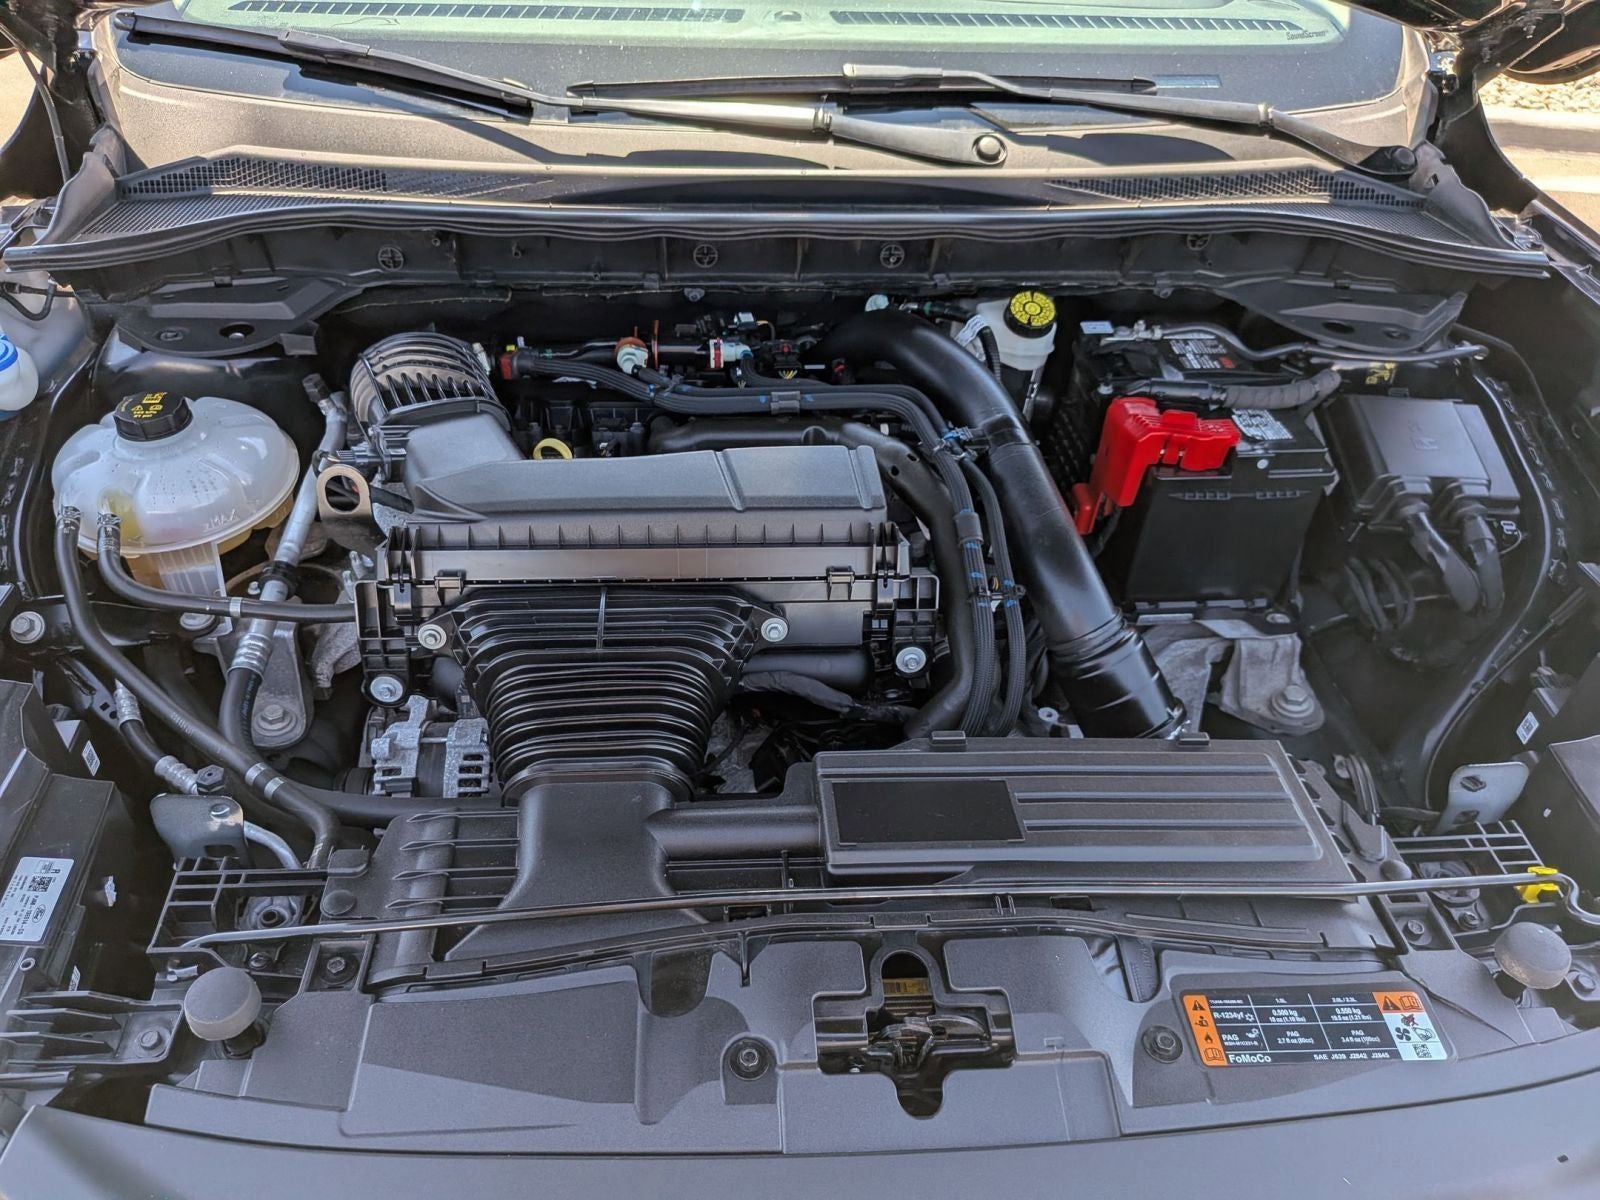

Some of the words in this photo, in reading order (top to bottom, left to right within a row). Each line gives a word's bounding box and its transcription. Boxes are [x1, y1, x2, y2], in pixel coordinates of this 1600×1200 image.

[1289, 1009, 1298, 1017] kg
[1352, 1007, 1362, 1015] kg
[1213, 1012, 1244, 1020] R-1234yf
[1228, 1053, 1272, 1063] FoMoCo
